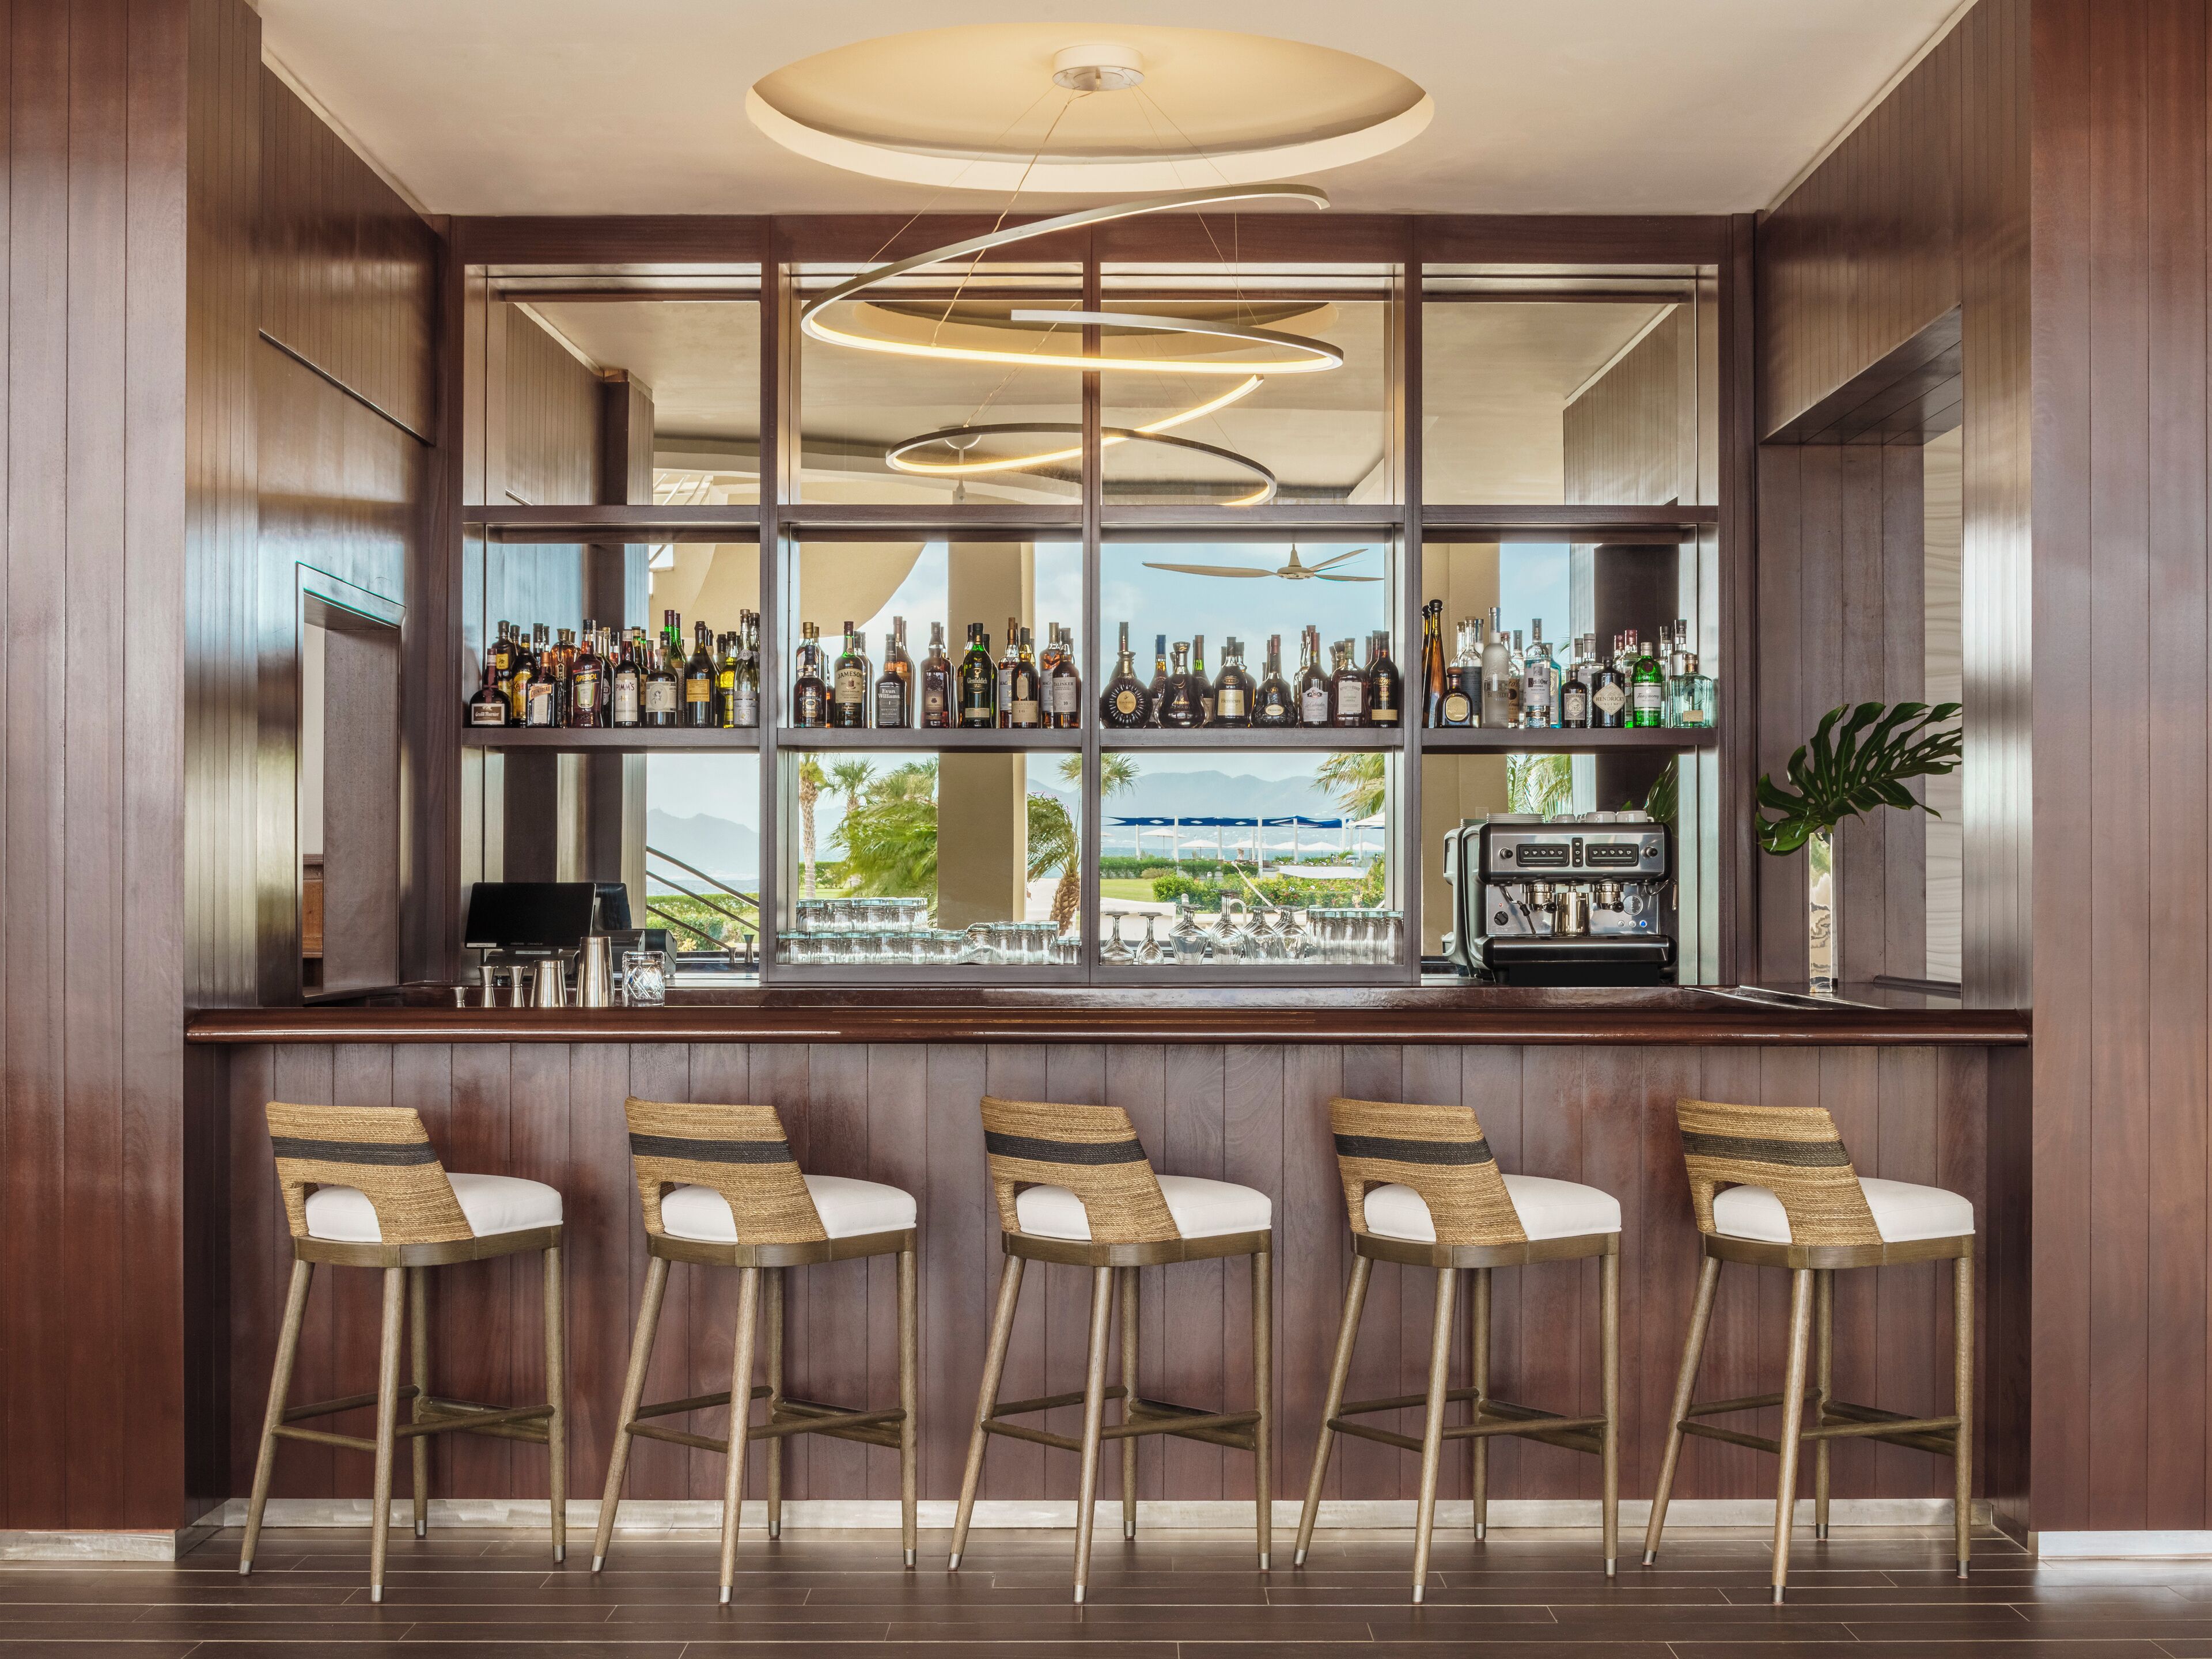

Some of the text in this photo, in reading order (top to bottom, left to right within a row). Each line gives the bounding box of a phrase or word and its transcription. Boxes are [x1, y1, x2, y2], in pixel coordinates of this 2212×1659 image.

[575, 673, 597, 683] APEROL
[838, 671, 862, 679] JAMESON
[531, 684, 551, 698] COINTREAU
[616, 682, 635, 691] PIMM'S
